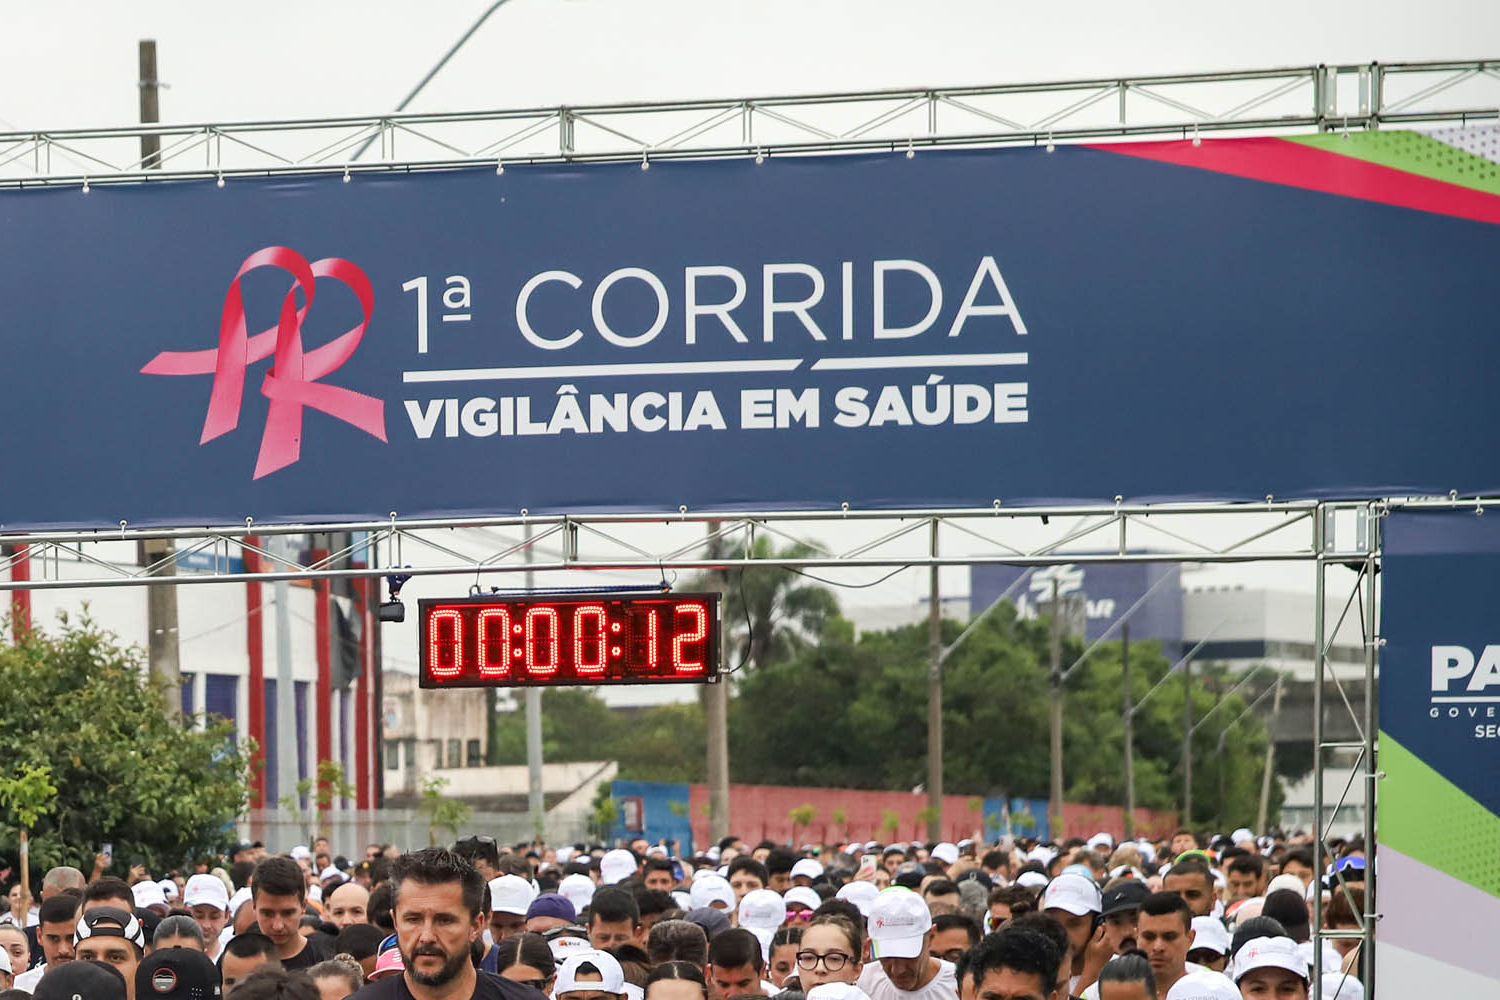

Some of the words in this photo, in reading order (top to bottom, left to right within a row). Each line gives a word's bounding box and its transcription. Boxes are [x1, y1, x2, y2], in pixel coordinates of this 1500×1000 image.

[403, 274, 472, 354] 1ª
[515, 256, 1028, 350] CORRIDA
[403, 384, 727, 440] VIGILÂNCIA
[741, 387, 819, 428] EM
[833, 373, 1029, 427] SAÚDE
[428, 603, 707, 677] 00:00:12
